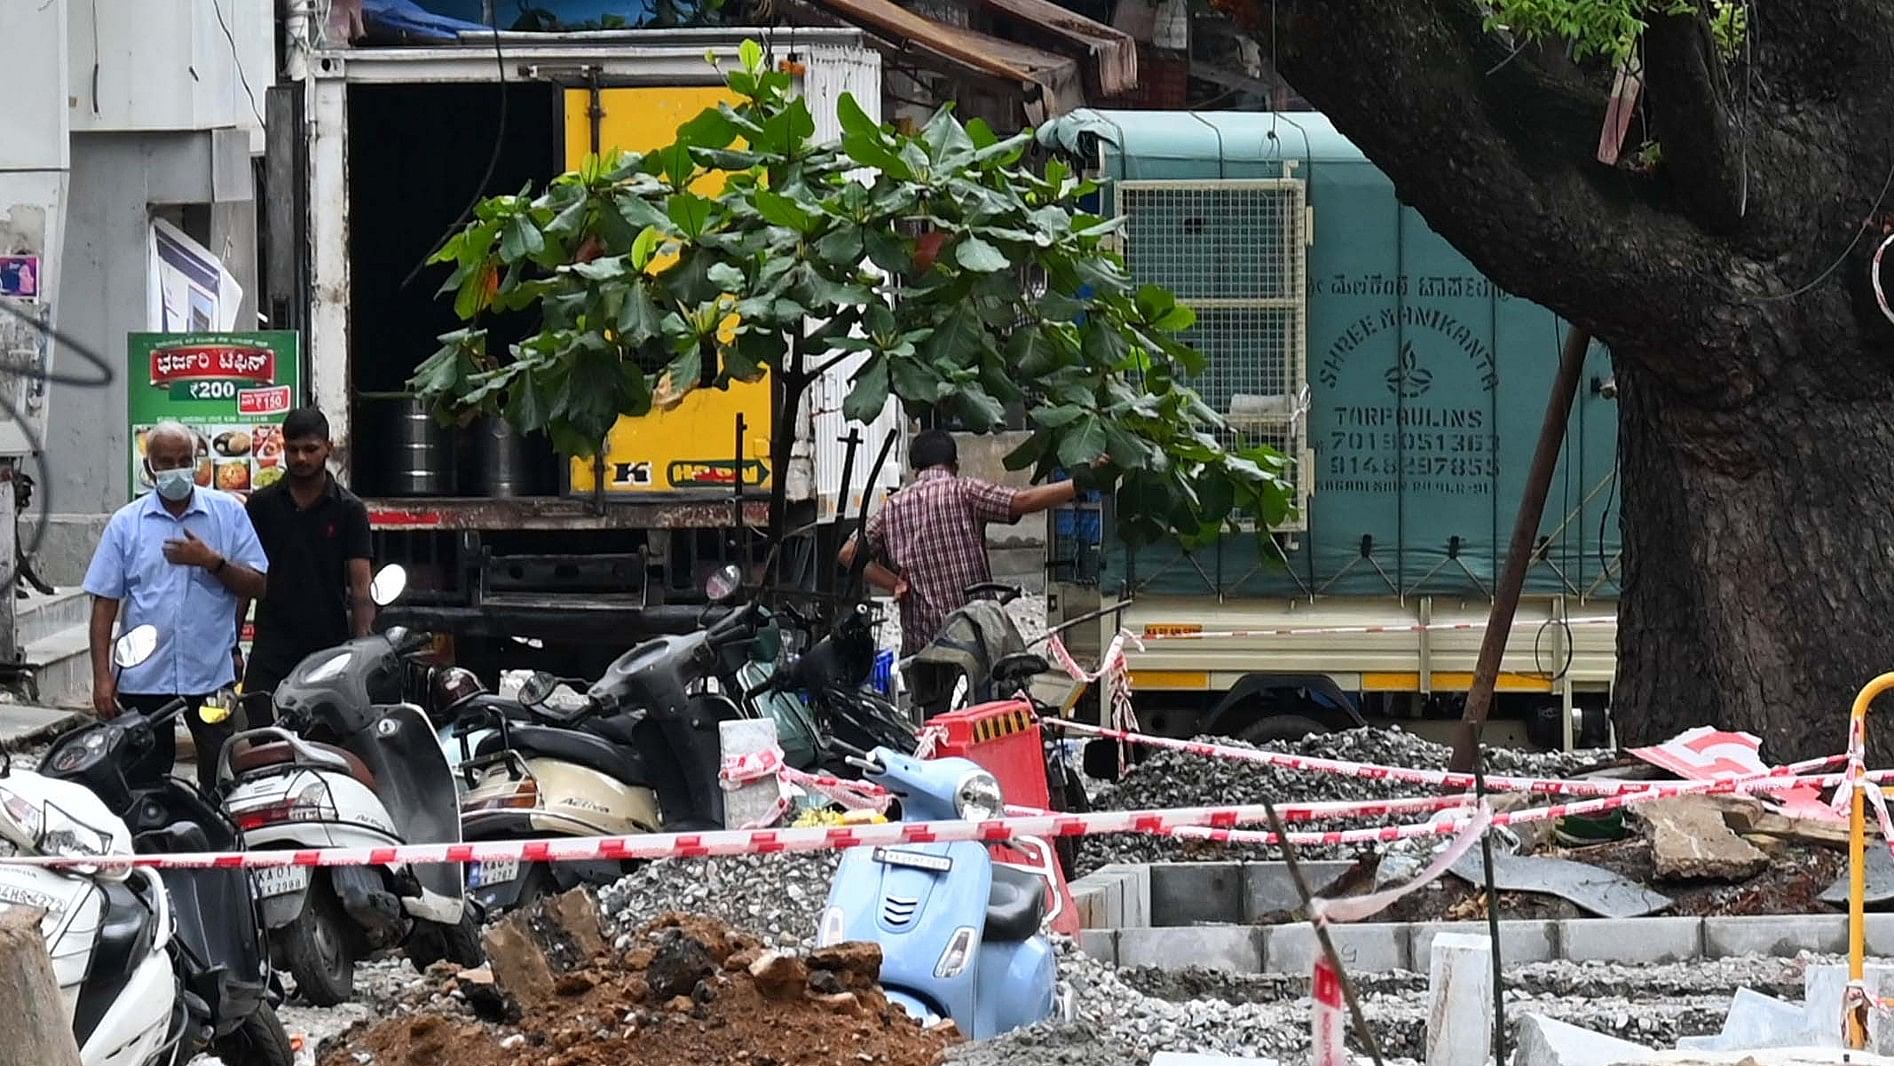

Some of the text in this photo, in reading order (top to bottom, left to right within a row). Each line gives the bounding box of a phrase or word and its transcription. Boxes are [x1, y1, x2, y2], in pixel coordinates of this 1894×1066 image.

[1319, 314, 1378, 389] SHREE
[190, 382, 236, 399] ₹200
[1334, 406, 1483, 429] TARPAULINS
